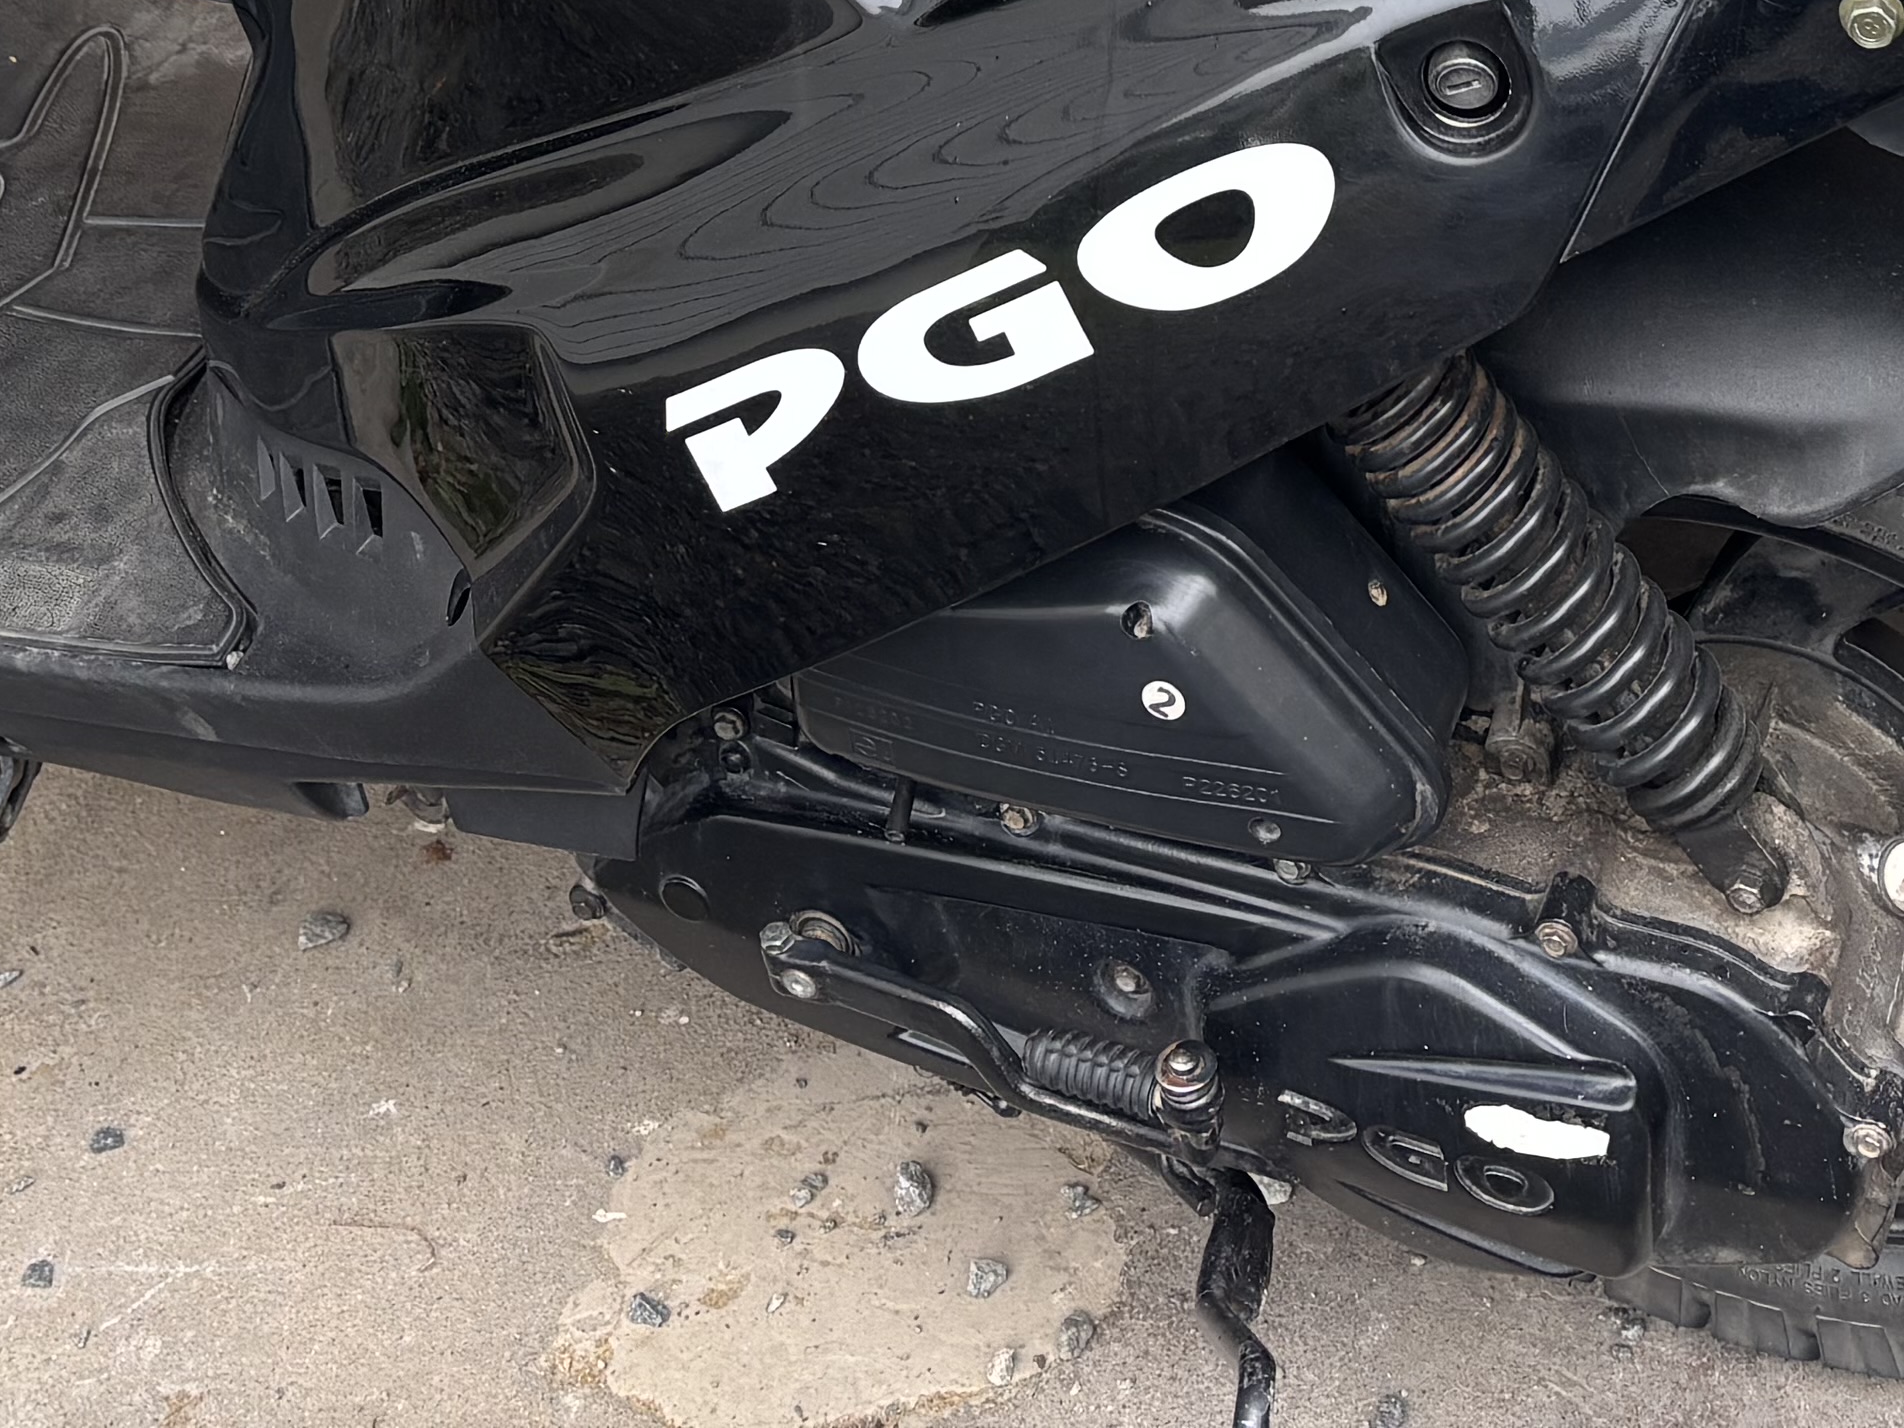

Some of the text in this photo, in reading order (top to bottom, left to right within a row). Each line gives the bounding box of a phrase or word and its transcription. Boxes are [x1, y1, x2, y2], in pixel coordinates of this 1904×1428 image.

[664, 141, 1336, 513] PGO
[1148, 687, 1176, 718] 2
[1277, 1089, 1555, 1217] PGO
[1739, 1265, 1795, 1288] NYLON
[1804, 1282, 1852, 1300] PLIES
